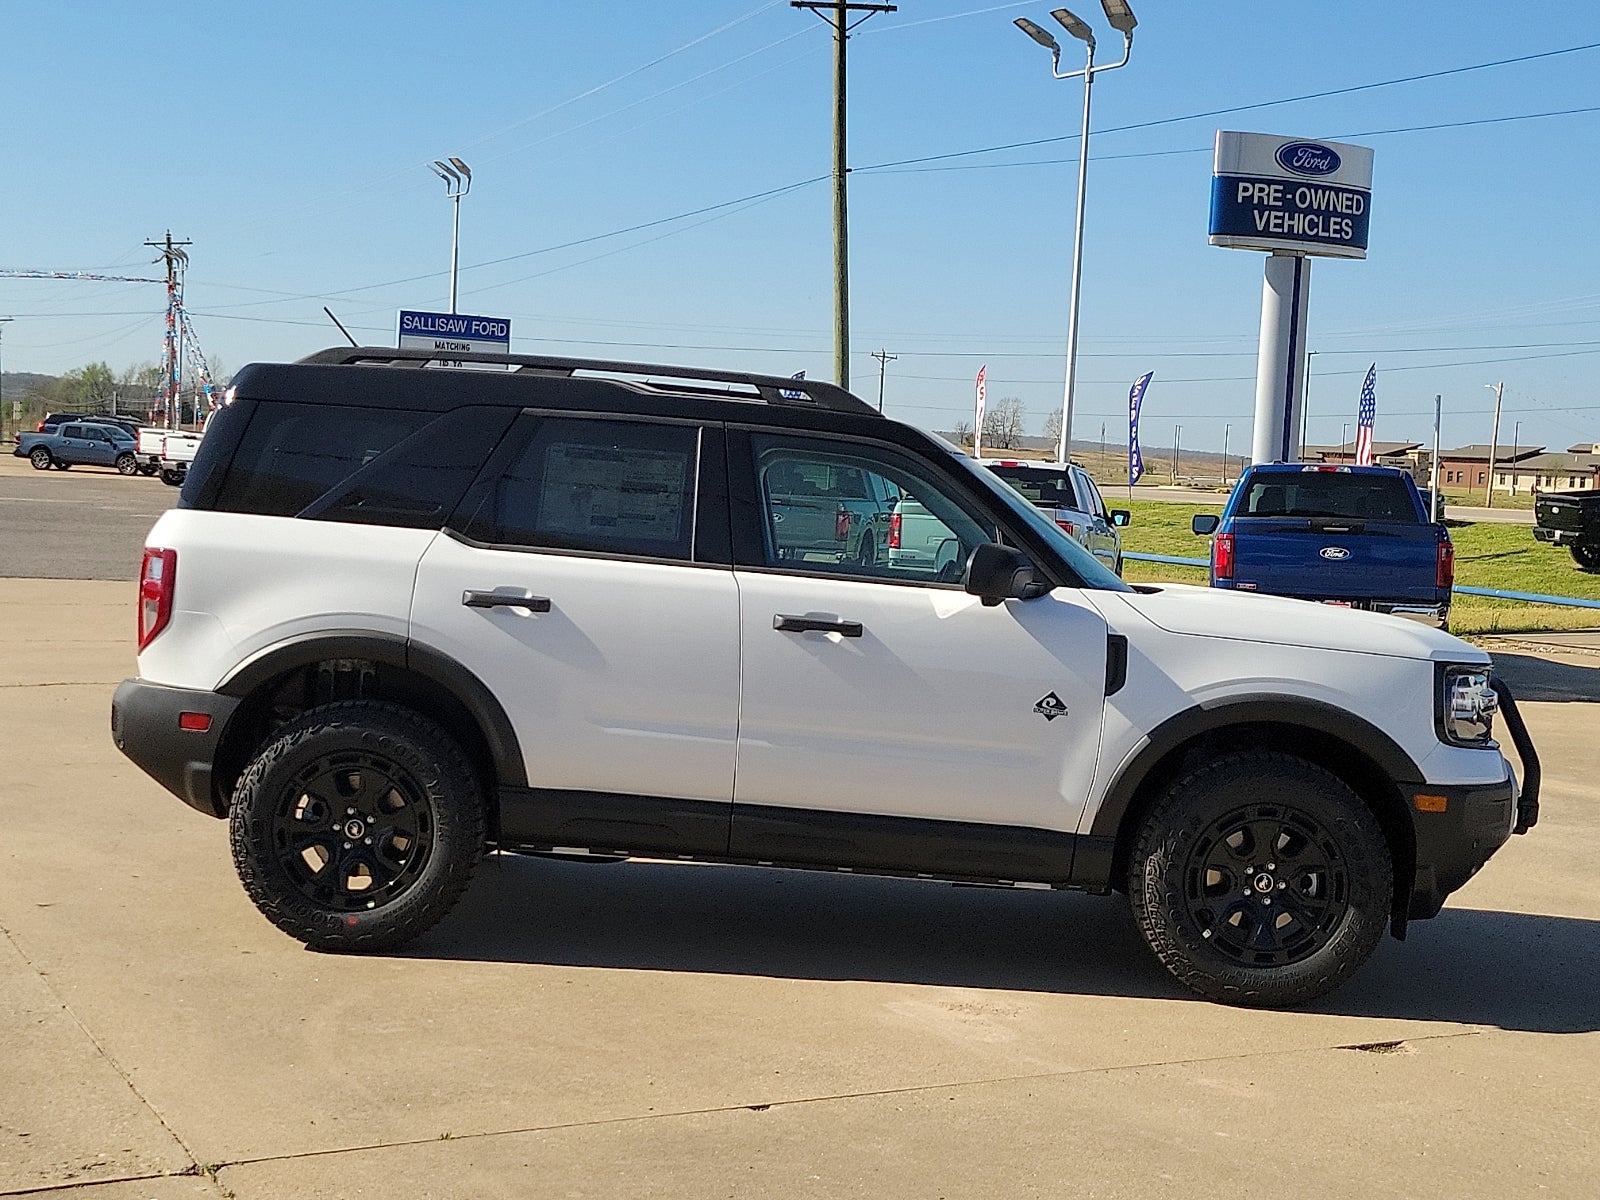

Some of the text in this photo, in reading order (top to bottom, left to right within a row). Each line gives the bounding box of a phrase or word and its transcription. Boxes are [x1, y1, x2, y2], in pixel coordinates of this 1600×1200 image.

[1293, 147, 1331, 171] Ford
[1253, 209, 1353, 240] VEHICLES
[403, 316, 507, 336] SALLISAW FORD
[434, 341, 471, 351] MATCHING
[1131, 376, 1146, 478] USED CARS
